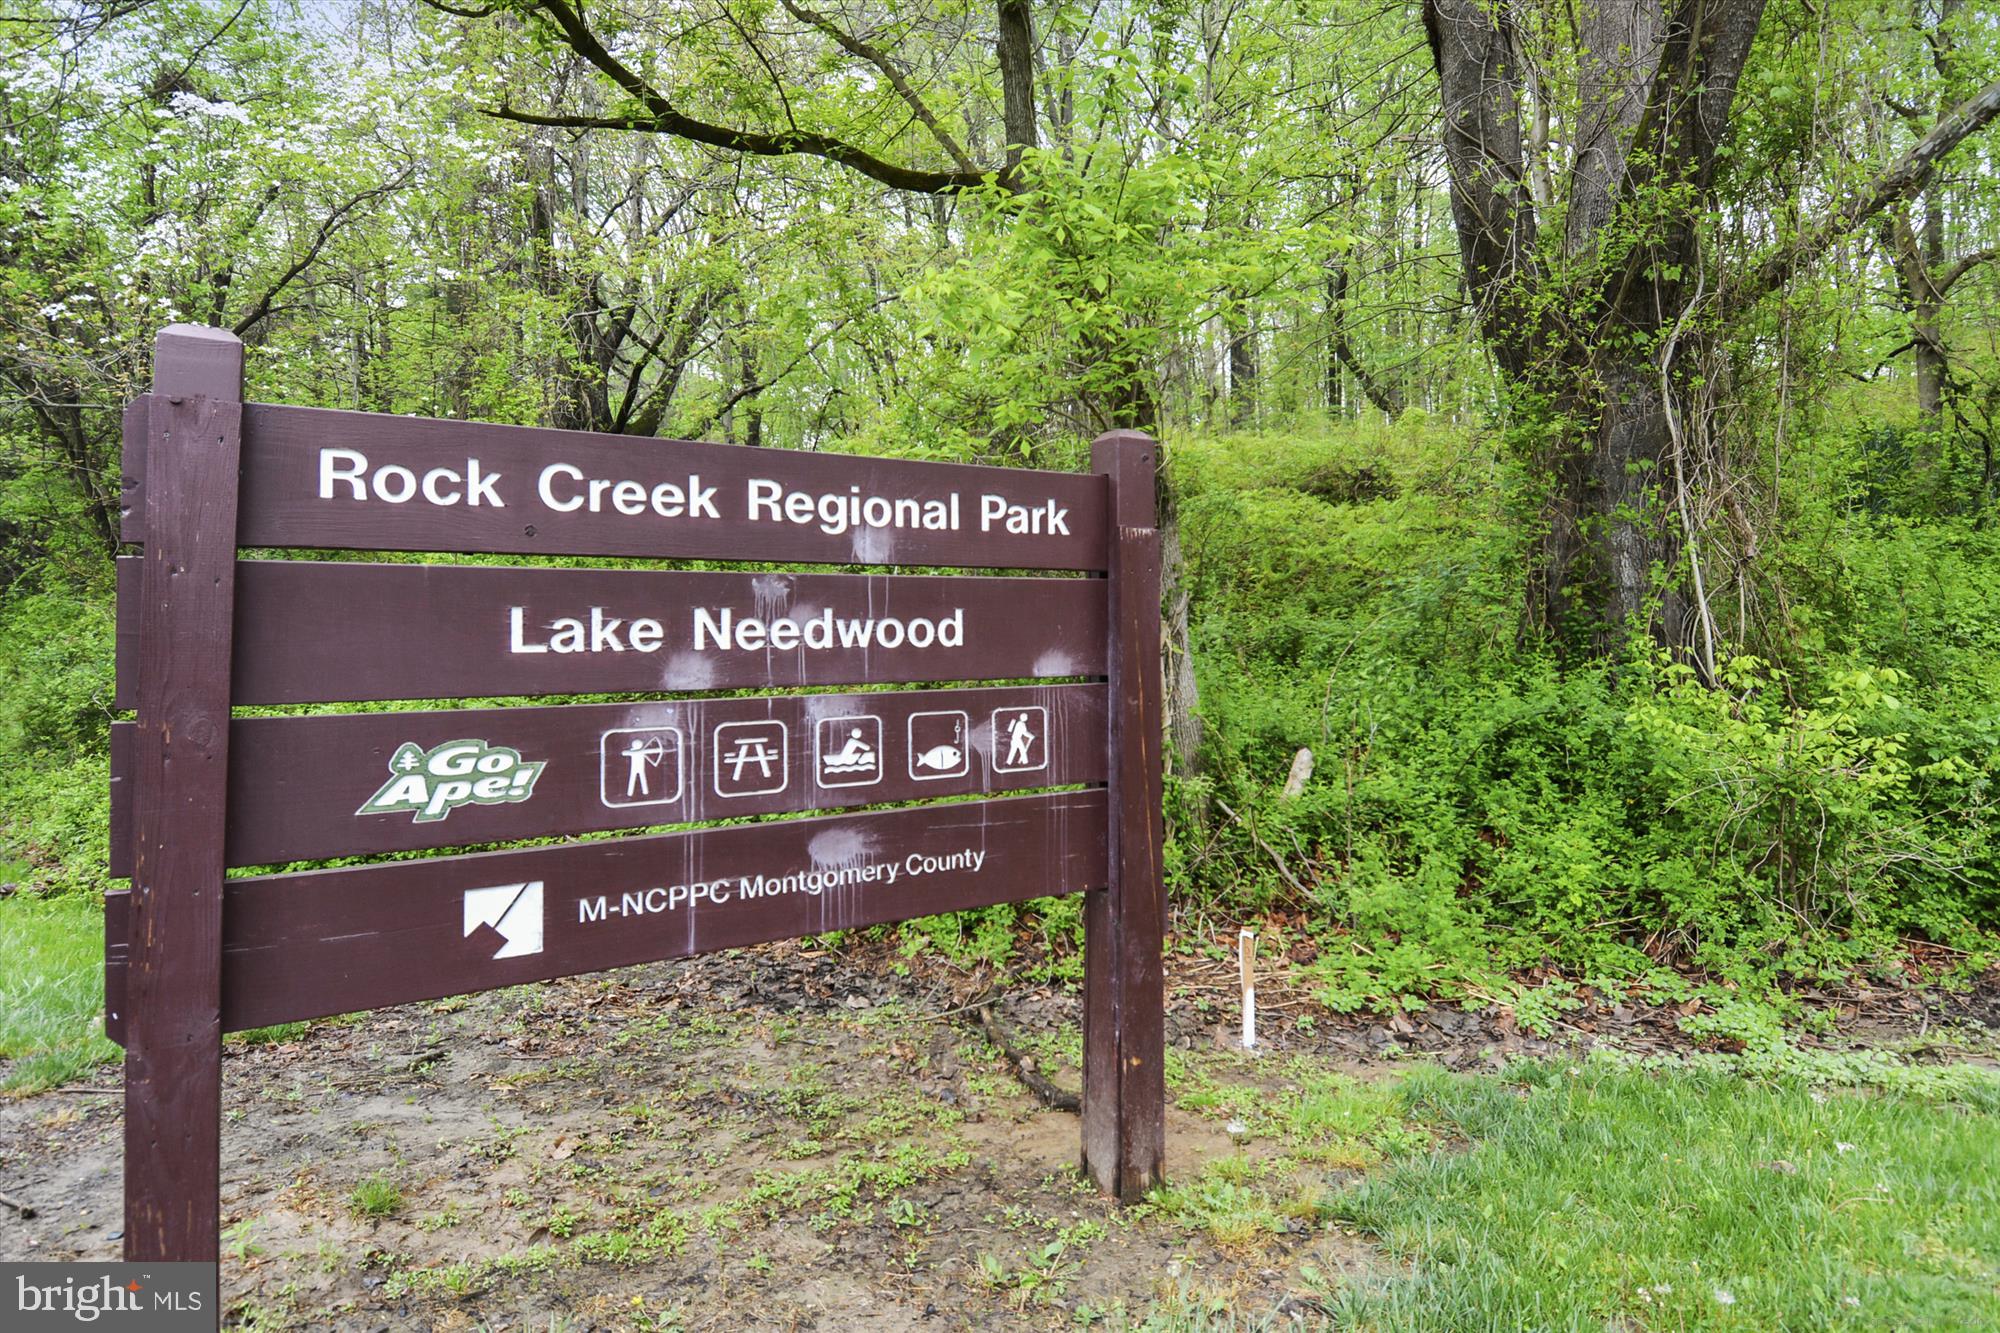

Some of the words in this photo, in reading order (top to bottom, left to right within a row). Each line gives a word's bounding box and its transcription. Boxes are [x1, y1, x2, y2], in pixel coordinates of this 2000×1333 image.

[319, 447, 505, 508] Rock
[538, 462, 722, 519] Creek
[747, 478, 960, 535] Regional
[980, 494, 1071, 536] Park
[510, 606, 665, 654] Lake
[693, 607, 965, 652] Needwood
[427, 746, 514, 776] Go
[373, 768, 535, 815] Ape!
[578, 878, 731, 924] M-NCPPC
[739, 860, 900, 901] Montgomery
[904, 848, 986, 876] County
